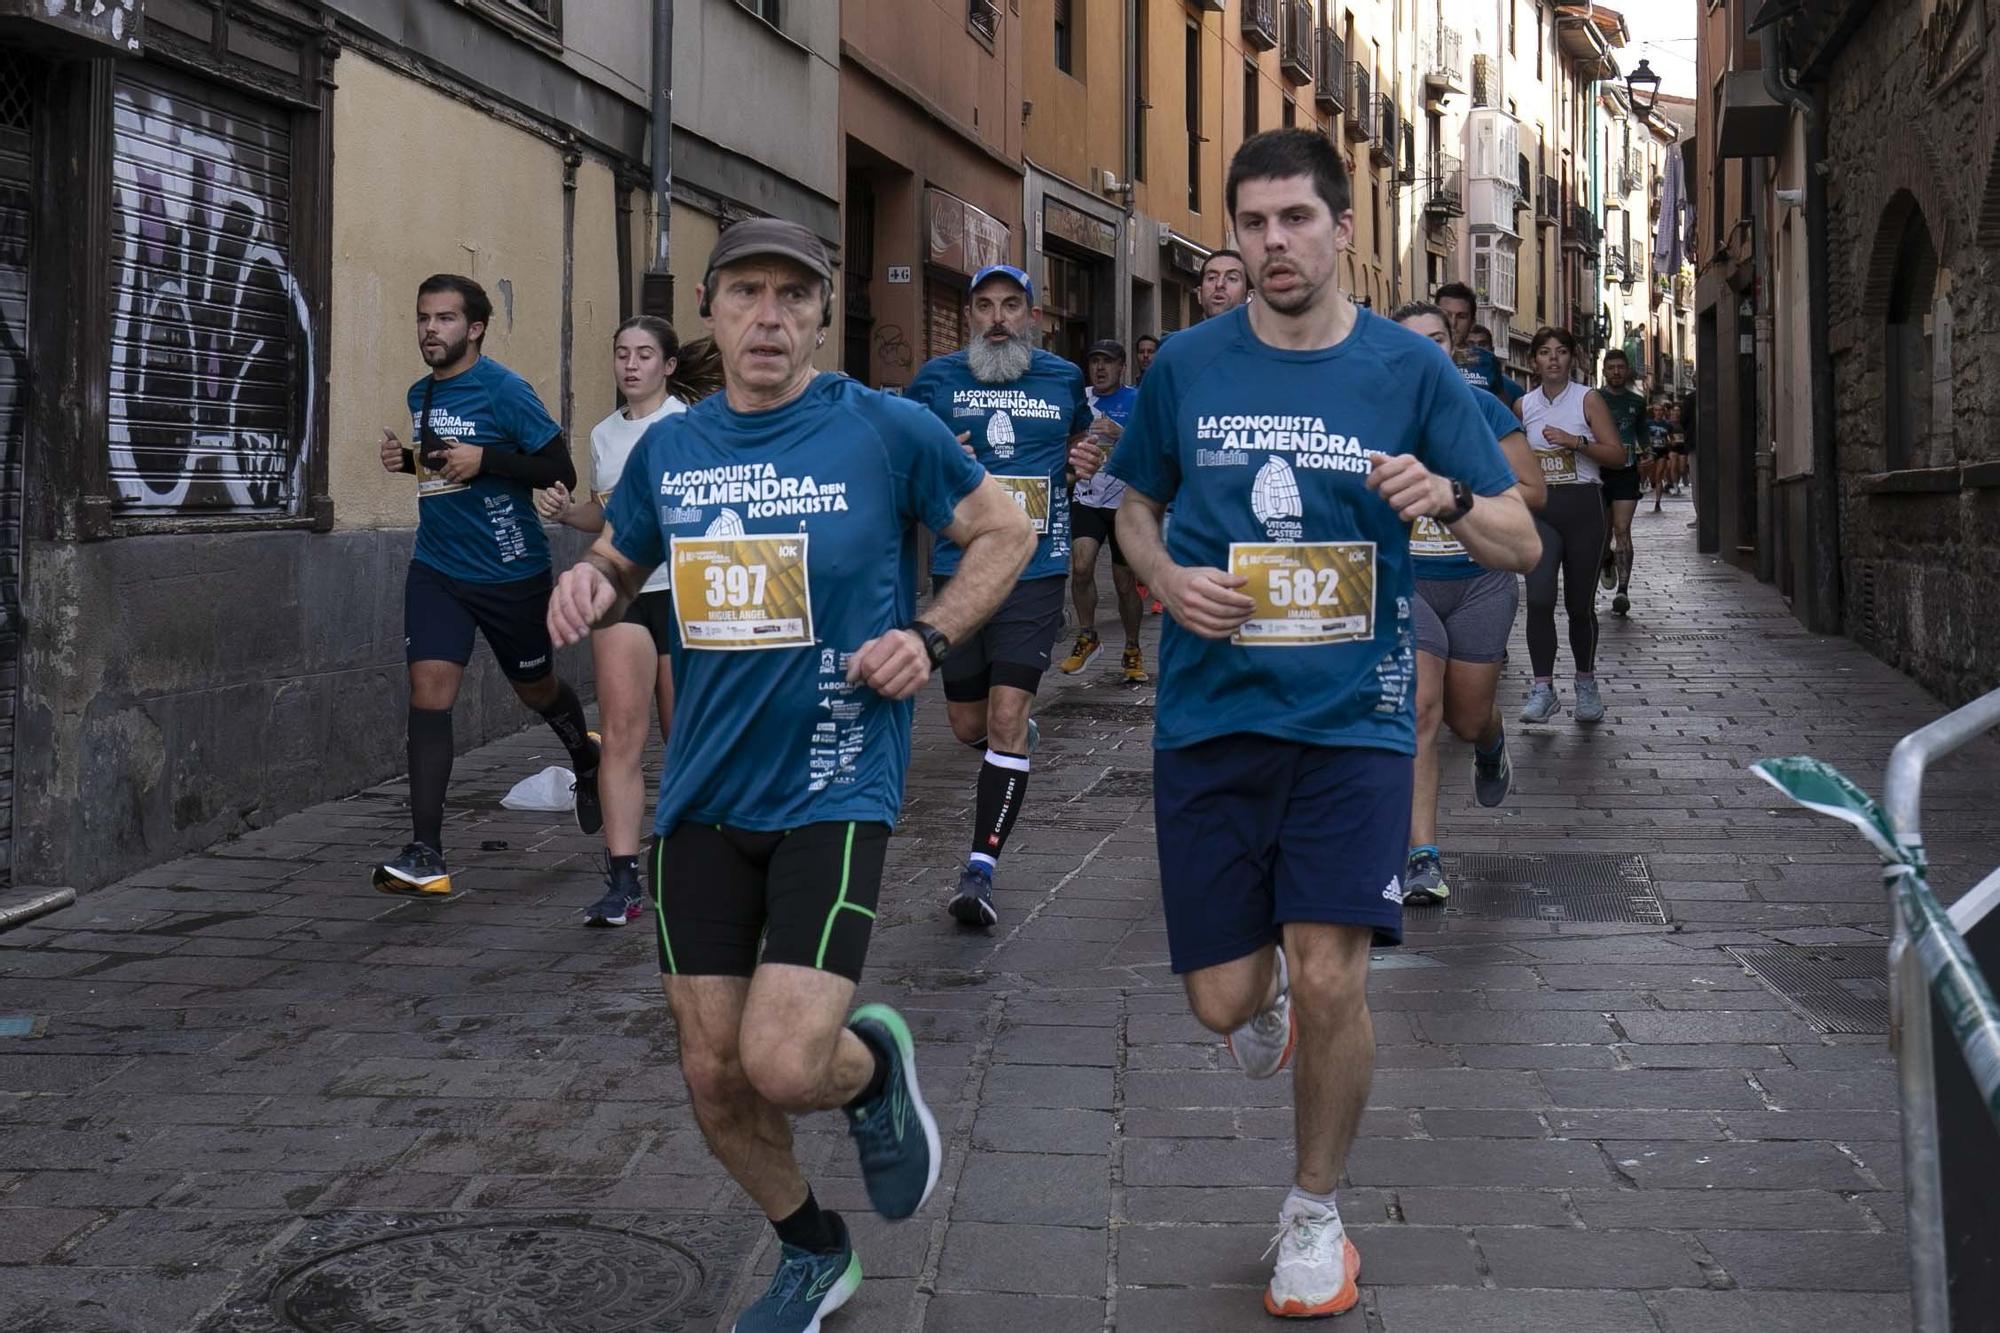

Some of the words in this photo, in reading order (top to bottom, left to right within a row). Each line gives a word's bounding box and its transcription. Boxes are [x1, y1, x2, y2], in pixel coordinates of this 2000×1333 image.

[890, 269, 909, 280] 46
[966, 390, 1026, 399] CONQUISTA
[969, 398, 1048, 409] ALMENDRA
[1011, 408, 1061, 420] KONKISTA
[1198, 416, 1218, 430] LA
[1219, 415, 1326, 433] CONQUISTA
[1197, 430, 1211, 439] DE
[1212, 430, 1225, 438] LA
[1222, 430, 1362, 457] ALMENDRA
[1296, 452, 1372, 474] KONKIST
[662, 471, 681, 487] LA
[682, 463, 776, 487] CONQUISTA
[661, 486, 674, 495] DE
[674, 486, 686, 496] LA
[681, 476, 819, 507] ALMENDRA
[819, 482, 846, 495] REN
[747, 495, 849, 519] KONKISTA
[1266, 521, 1302, 530] VITORIA
[1266, 529, 1303, 538] GASTEIZ
[779, 544, 797, 557] 10K
[704, 565, 767, 607] 397
[1268, 568, 1339, 606] 582
[708, 610, 737, 620] MIGUEL
